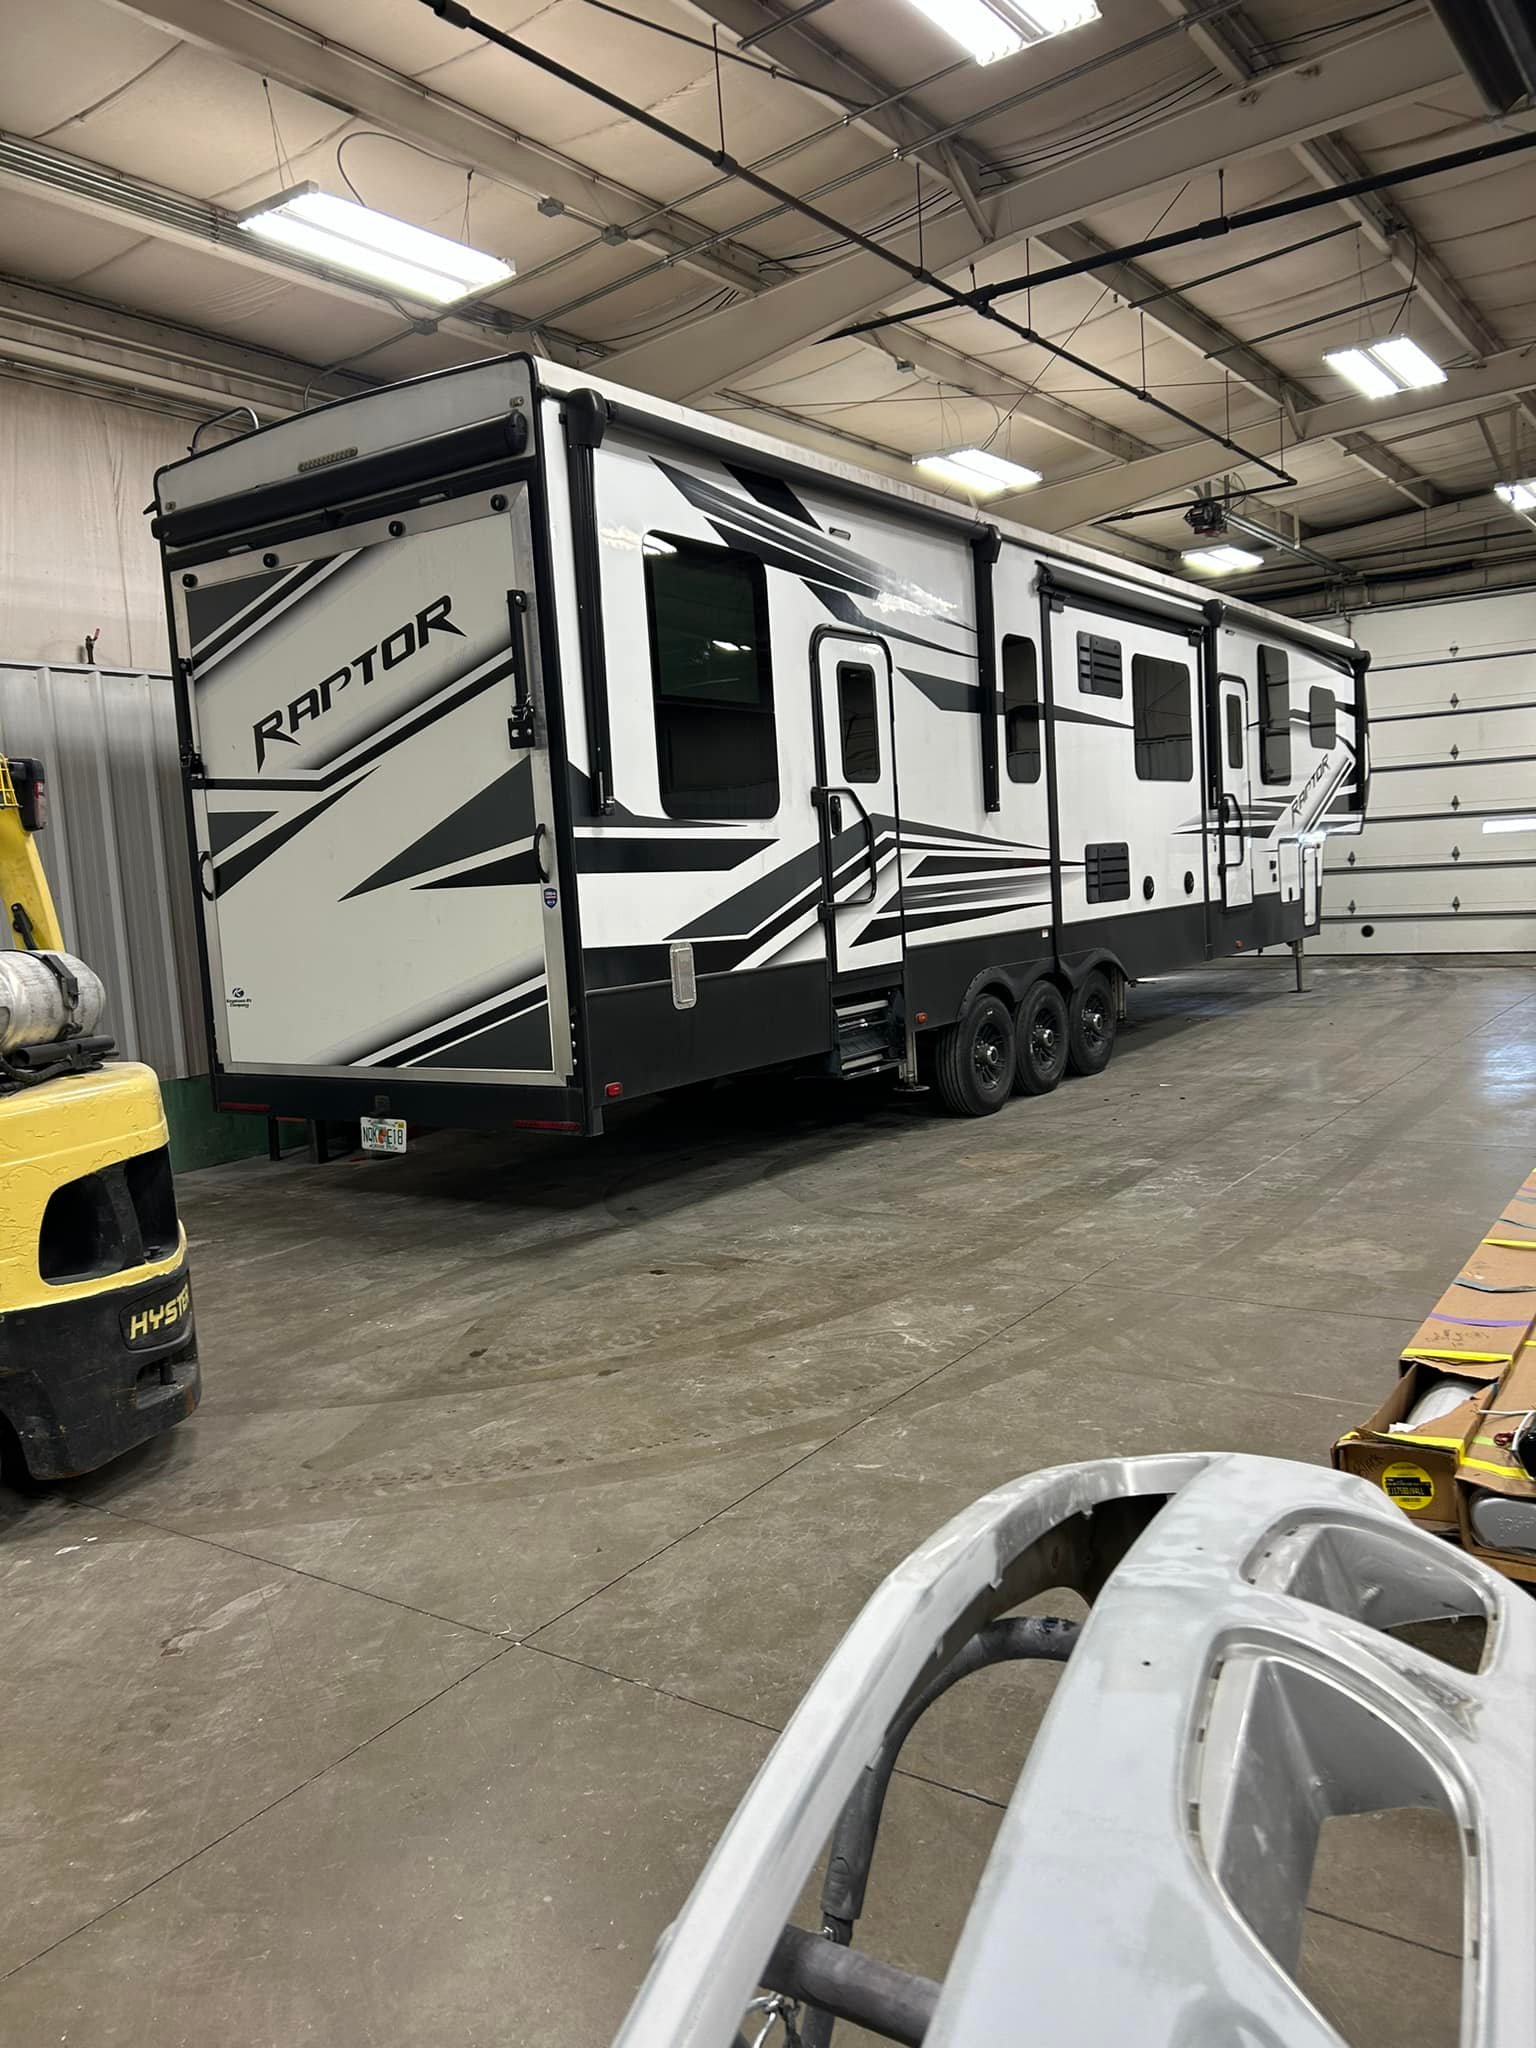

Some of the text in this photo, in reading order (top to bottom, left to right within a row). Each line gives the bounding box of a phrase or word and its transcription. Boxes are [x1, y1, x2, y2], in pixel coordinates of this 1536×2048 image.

[252, 594, 468, 774] RAPTOR
[1291, 753, 1331, 829] RAPTOR
[129, 1282, 190, 1341] HYSTE
